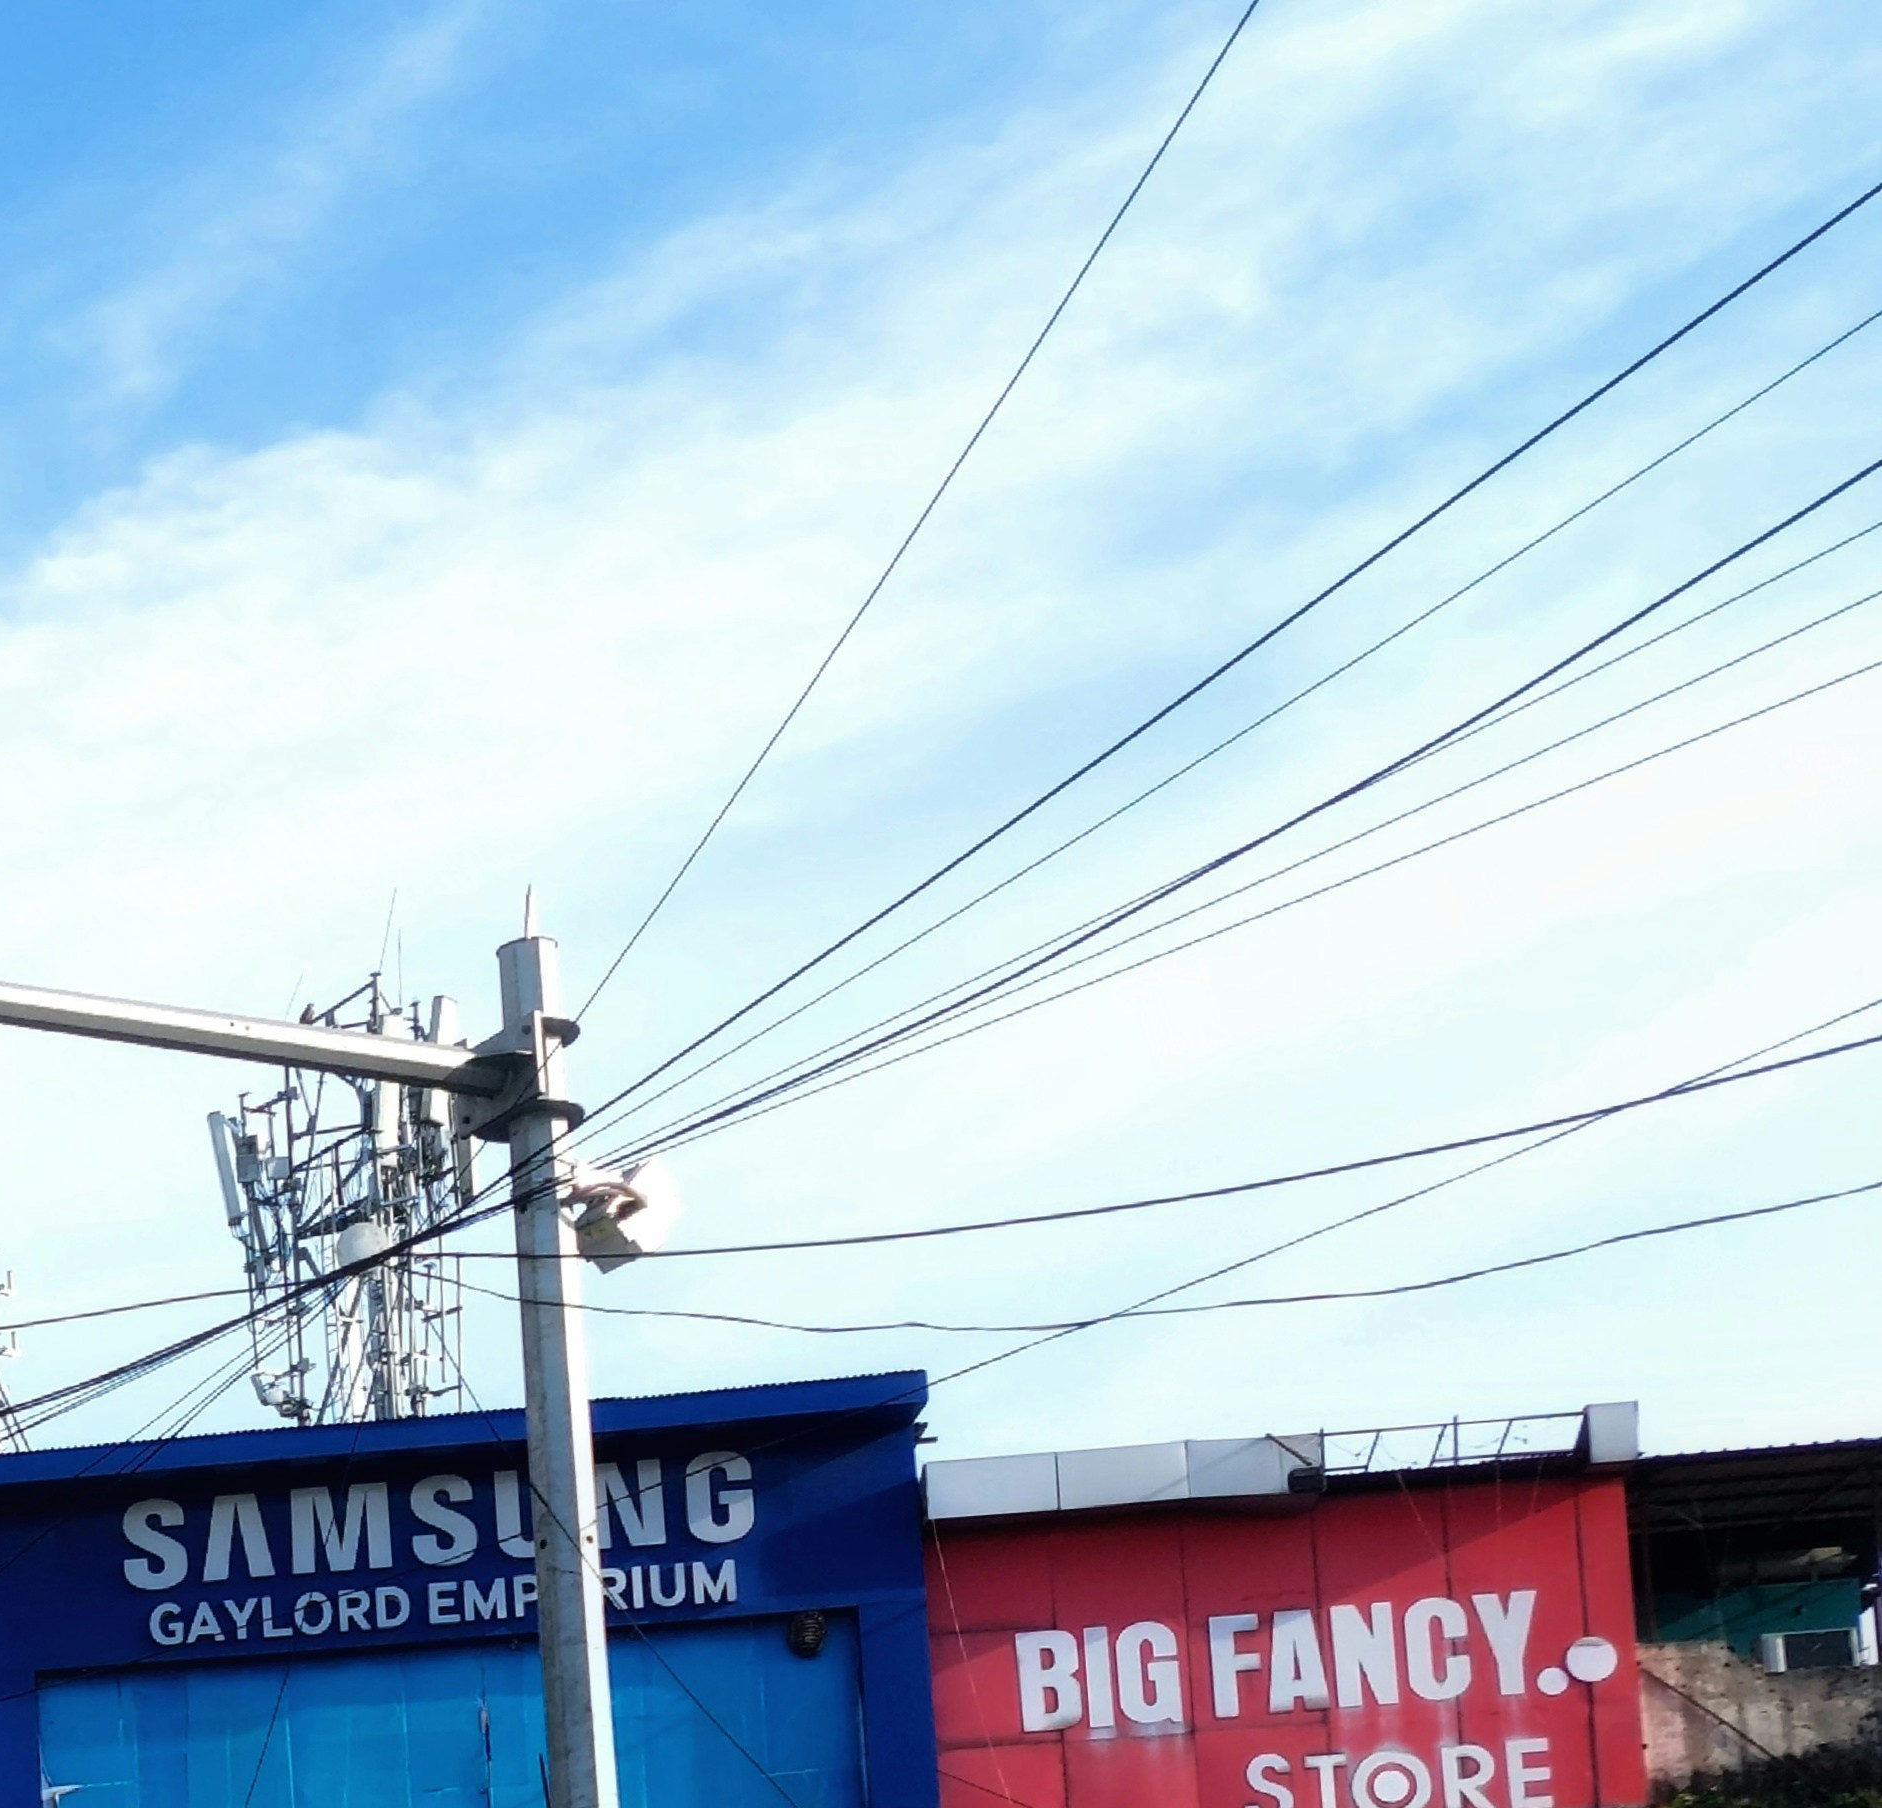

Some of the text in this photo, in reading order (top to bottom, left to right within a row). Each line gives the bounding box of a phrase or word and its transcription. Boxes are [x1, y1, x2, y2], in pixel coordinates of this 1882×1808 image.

[122, 1450, 755, 1591] SAMSUNG
[149, 1559, 737, 1646] GAYLORD EMPRIUM
[1014, 1620, 1186, 1734] BIG
